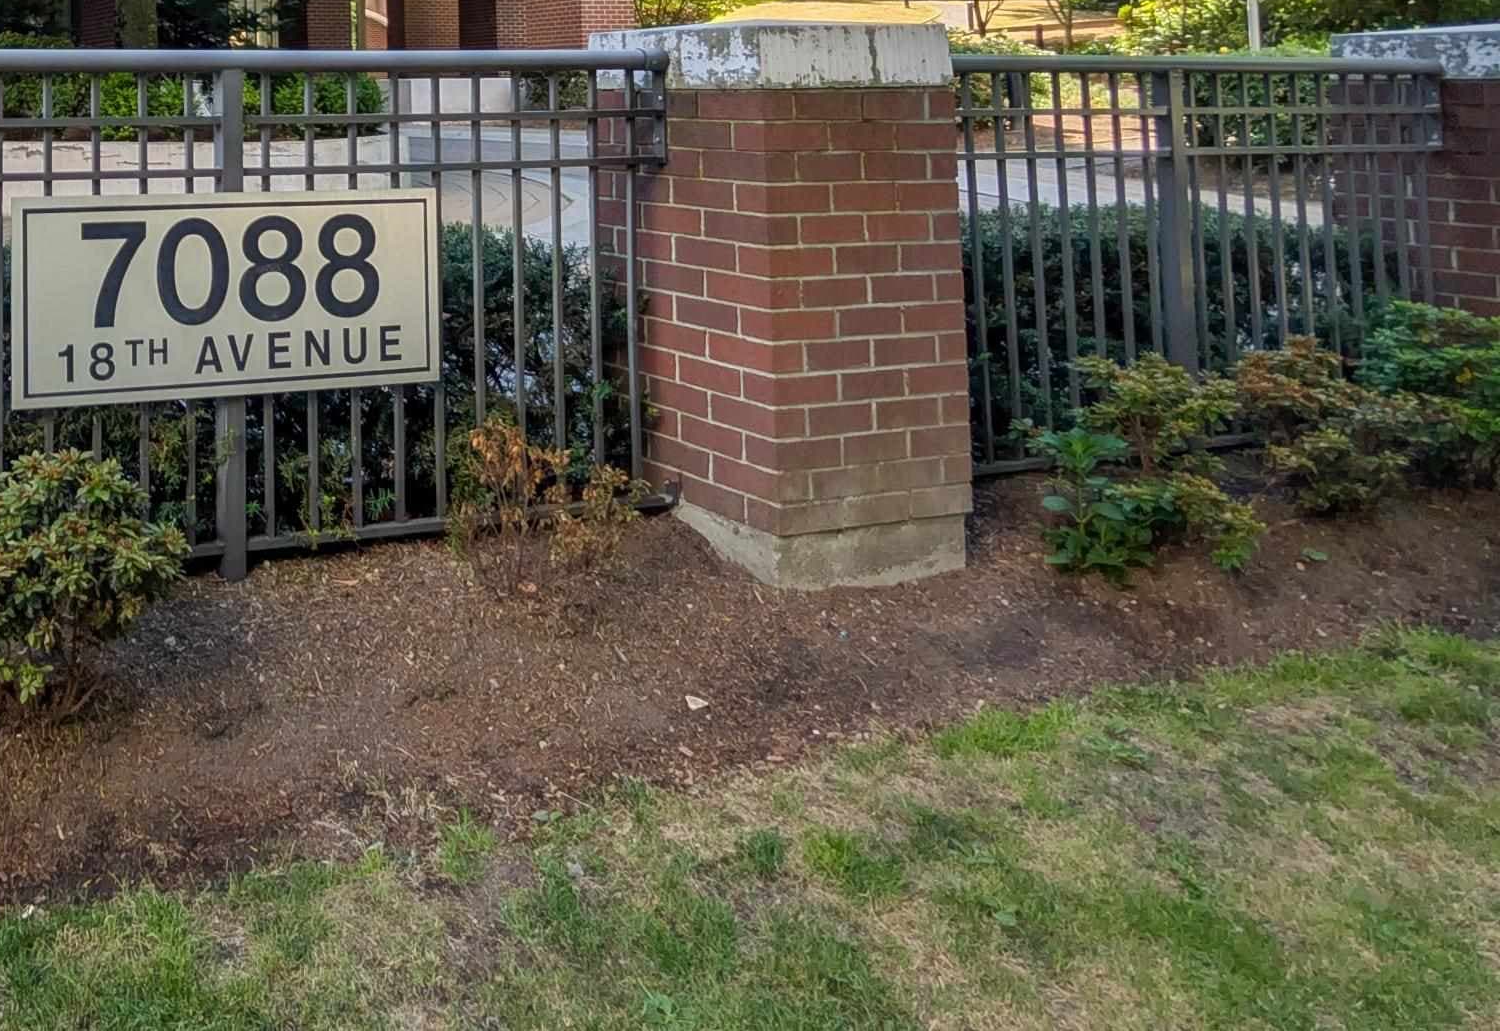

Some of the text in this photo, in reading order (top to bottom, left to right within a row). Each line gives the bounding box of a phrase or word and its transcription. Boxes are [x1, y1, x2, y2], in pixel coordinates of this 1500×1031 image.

[81, 213, 380, 329] 7088
[57, 324, 403, 383] 18TH AVENUE
